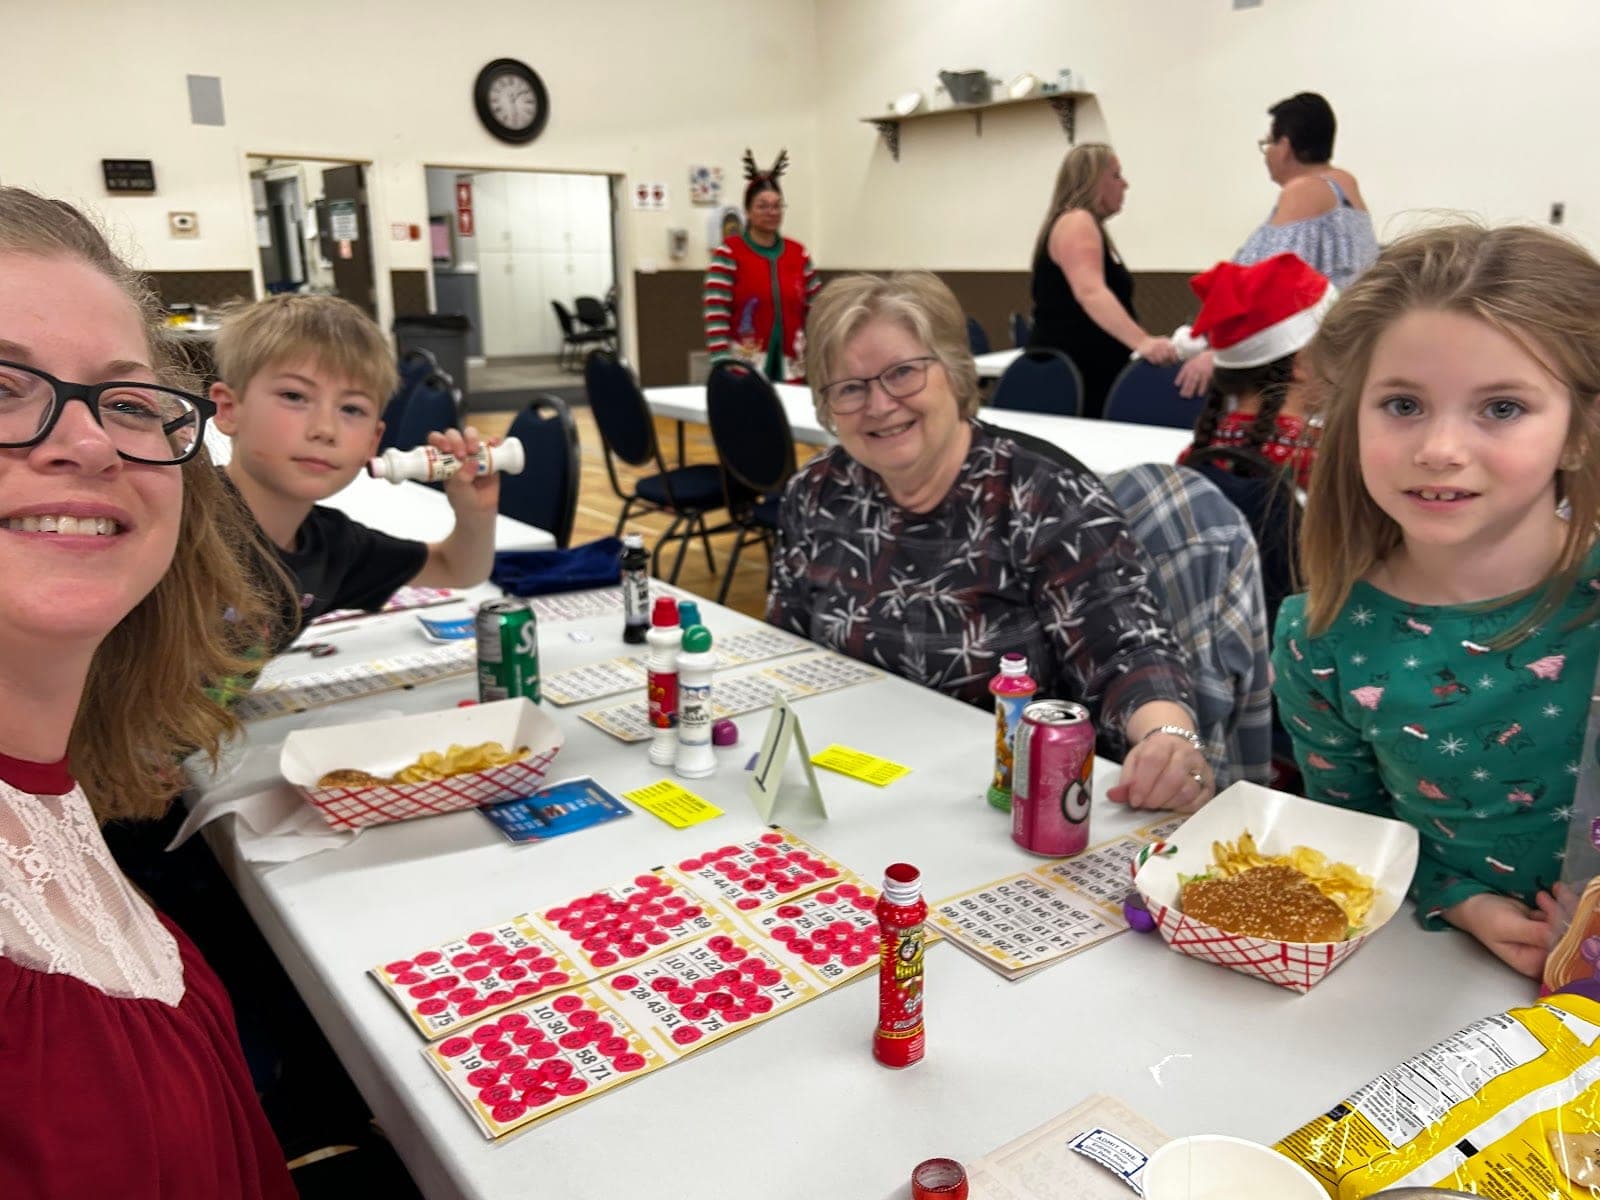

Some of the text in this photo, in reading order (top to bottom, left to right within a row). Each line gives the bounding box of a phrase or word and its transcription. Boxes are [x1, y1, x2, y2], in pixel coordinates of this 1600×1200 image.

[777, 843, 793, 853] 25
[739, 854, 756, 864] 19
[1069, 860, 1088, 870] 67
[1052, 866, 1071, 876] 62
[699, 869, 744, 899] 22 44 51
[1014, 880, 1034, 890] 73
[1070, 875, 1090, 886] 59
[1106, 878, 1125, 888] 34
[760, 889, 778, 900] 75
[996, 886, 1017, 897] 70
[1088, 884, 1107, 895] 40
[1013, 896, 1034, 908] 53
[1049, 900, 1070, 910] 36
[803, 901, 835, 922] 2 19
[836, 904, 873, 927] 17 44
[1031, 907, 1052, 918] 34
[1069, 910, 1090, 921] 25
[693, 916, 713, 929] 69
[795, 917, 815, 929] 25
[959, 899, 1047, 953] 9 29 37 58 68
[978, 893, 1071, 947] 14 19 57 69
[1052, 918, 1072, 928] 21
[1091, 922, 1105, 930] 1
[498, 926, 528, 949] 10 30
[670, 925, 689, 938] 71
[939, 906, 1033, 961] 11 28 45 51 66
[762, 917, 776, 926] 6
[823, 963, 844, 976] 69
[689, 947, 724, 972] 15 22
[431, 964, 450, 976] 17
[449, 945, 500, 990] 2 58
[665, 958, 701, 981] 10 30
[774, 984, 796, 1000] 71
[643, 969, 723, 1031] 2 75
[630, 987, 682, 1028] 28 43 51
[433, 1011, 455, 1027] 75
[534, 1005, 612, 1081] 10 30 58 71
[460, 1055, 483, 1070] 19
[1096, 1136, 1138, 1161] ADMIT ONE
